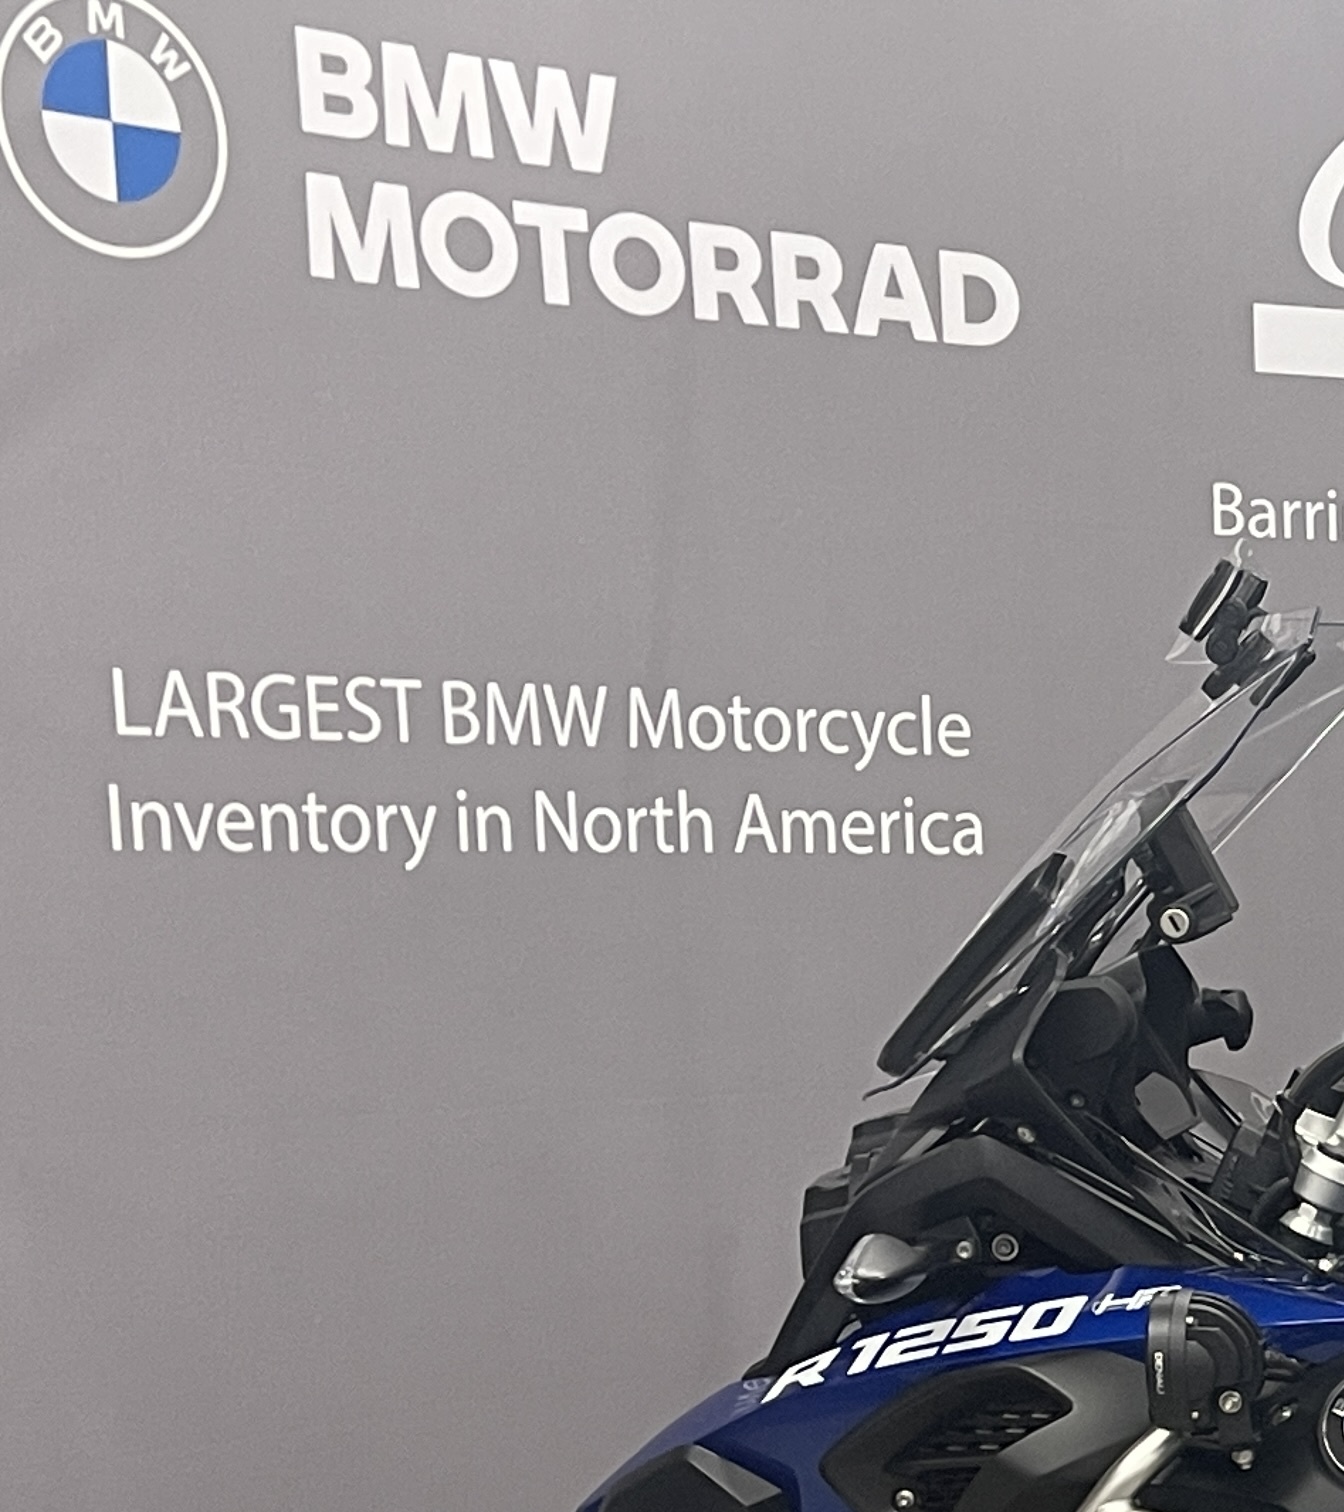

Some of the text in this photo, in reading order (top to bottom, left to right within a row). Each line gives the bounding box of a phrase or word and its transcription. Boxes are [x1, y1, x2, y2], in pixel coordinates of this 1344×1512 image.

[22, 0, 193, 82] BMW
[293, 24, 617, 174] BMW
[304, 170, 1021, 347] MOTORRAD
[111, 666, 972, 772] LARGEST BMW Motorcycle
[107, 782, 985, 872] Inventory in North America
